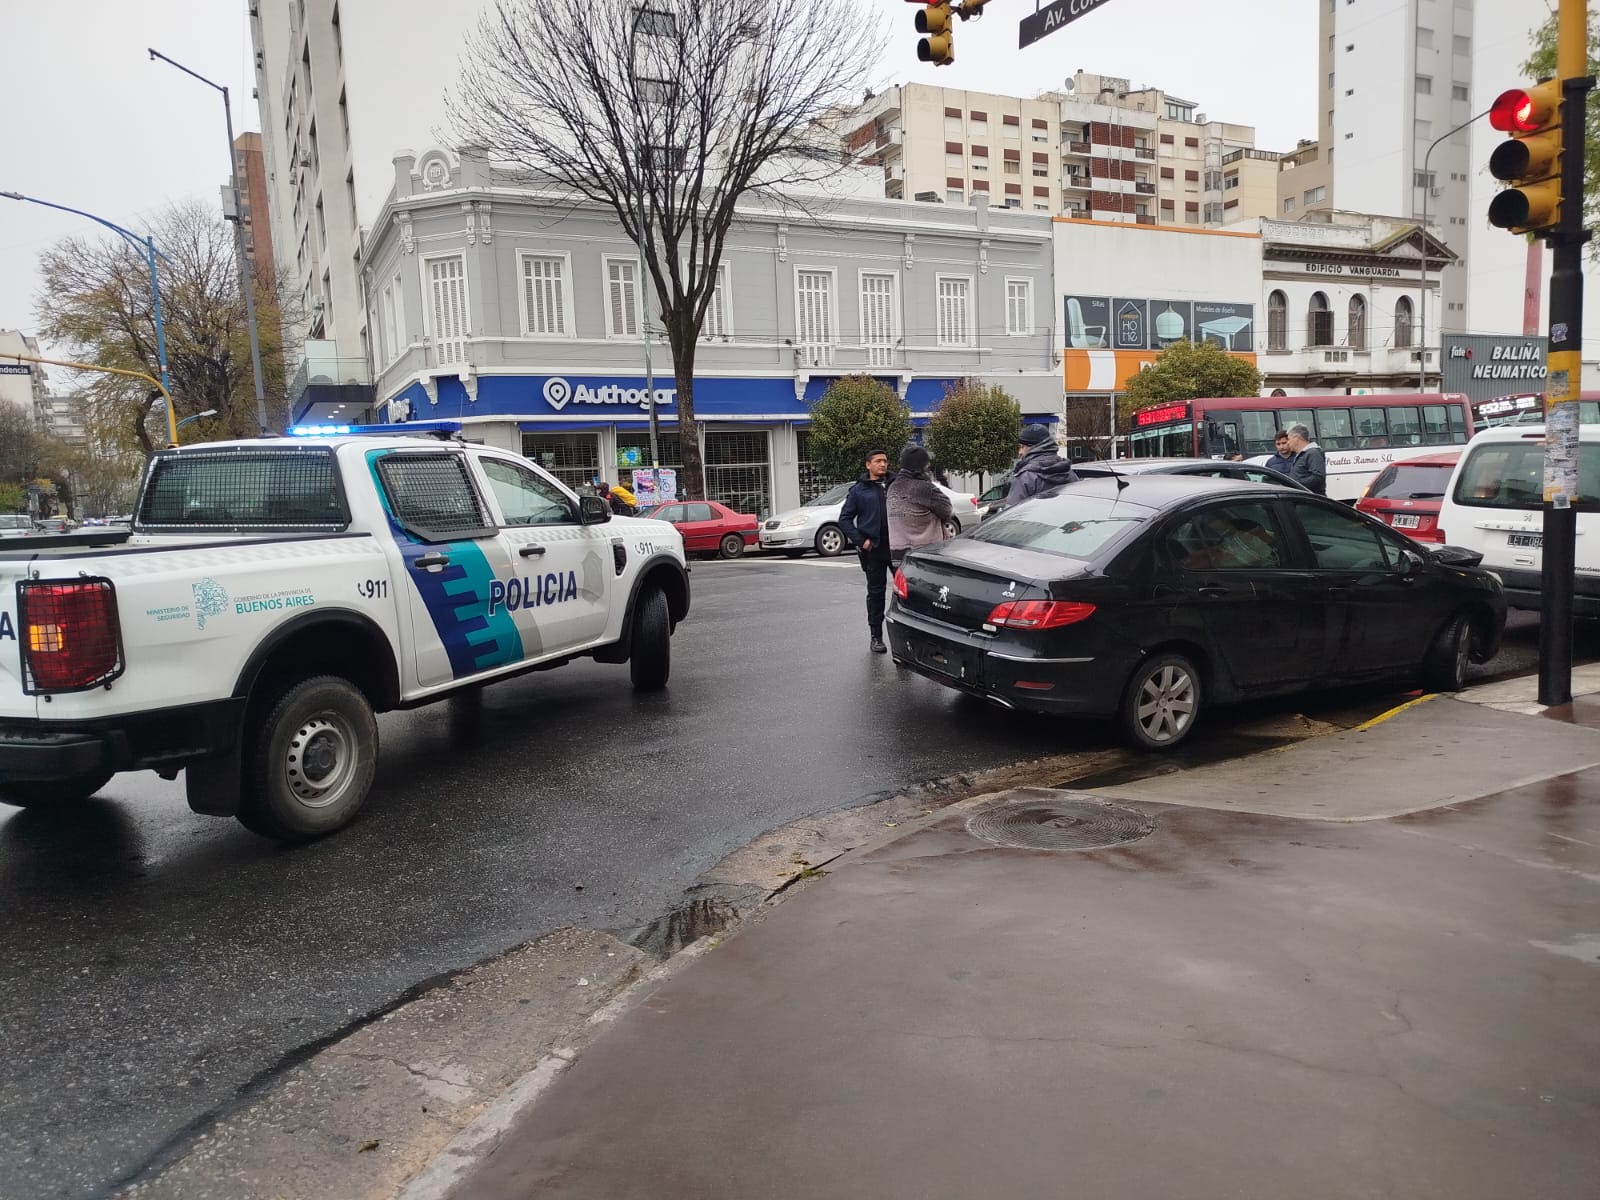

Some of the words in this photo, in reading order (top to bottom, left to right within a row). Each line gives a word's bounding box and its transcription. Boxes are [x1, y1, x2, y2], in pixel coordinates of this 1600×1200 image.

[1044, 7, 1066, 31] Av.
[1305, 263, 1342, 274] EDIFICIO
[1349, 266, 1400, 277] VANGUARDIA
[1492, 342, 1541, 360] BALIÑA
[1473, 365, 1548, 379] NEUMATICO
[572, 384, 678, 410] Authogar
[639, 542, 654, 555] 911
[366, 579, 387, 599] 911
[489, 570, 577, 616] POLICIA
[235, 598, 283, 615] BUENOS
[285, 594, 315, 608] AIRES
